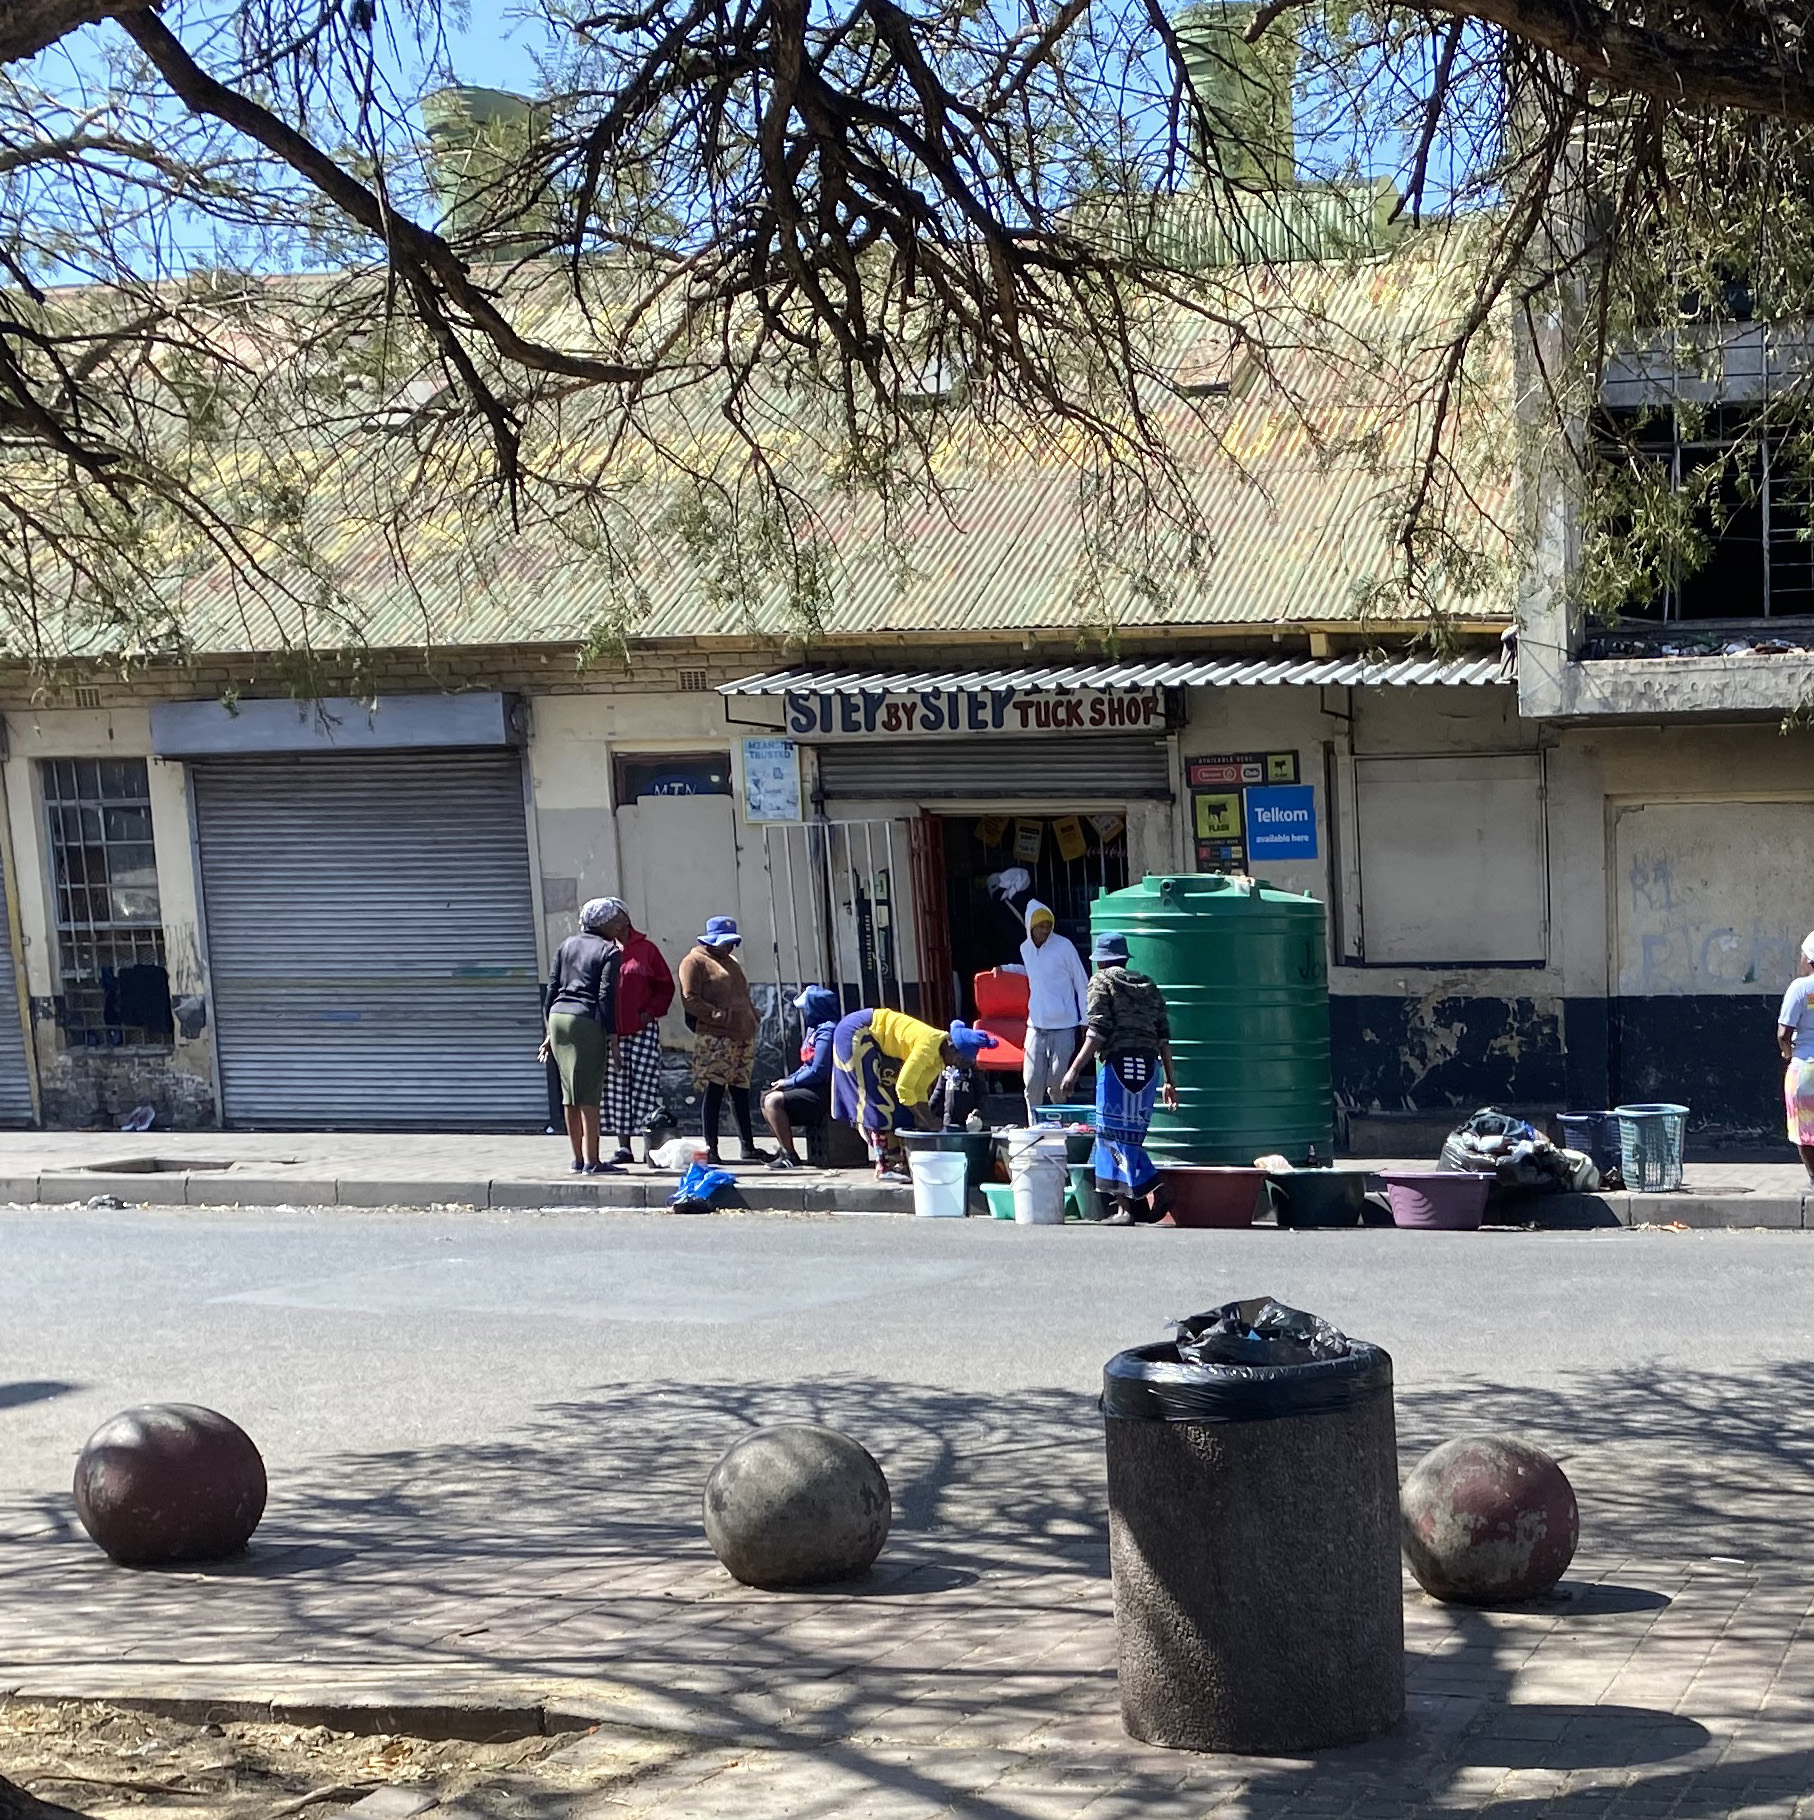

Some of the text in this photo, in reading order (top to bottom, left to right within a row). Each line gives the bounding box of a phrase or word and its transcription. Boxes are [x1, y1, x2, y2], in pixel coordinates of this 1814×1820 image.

[881, 701, 917, 732] BY
[1012, 699, 1085, 729] TUCK
[1089, 695, 1159, 728] SHOP
[749, 750, 791, 759] TRUSTED
[654, 782, 697, 795] MTN
[1254, 806, 1309, 823] Telkom
[1255, 833, 1310, 843] available here
